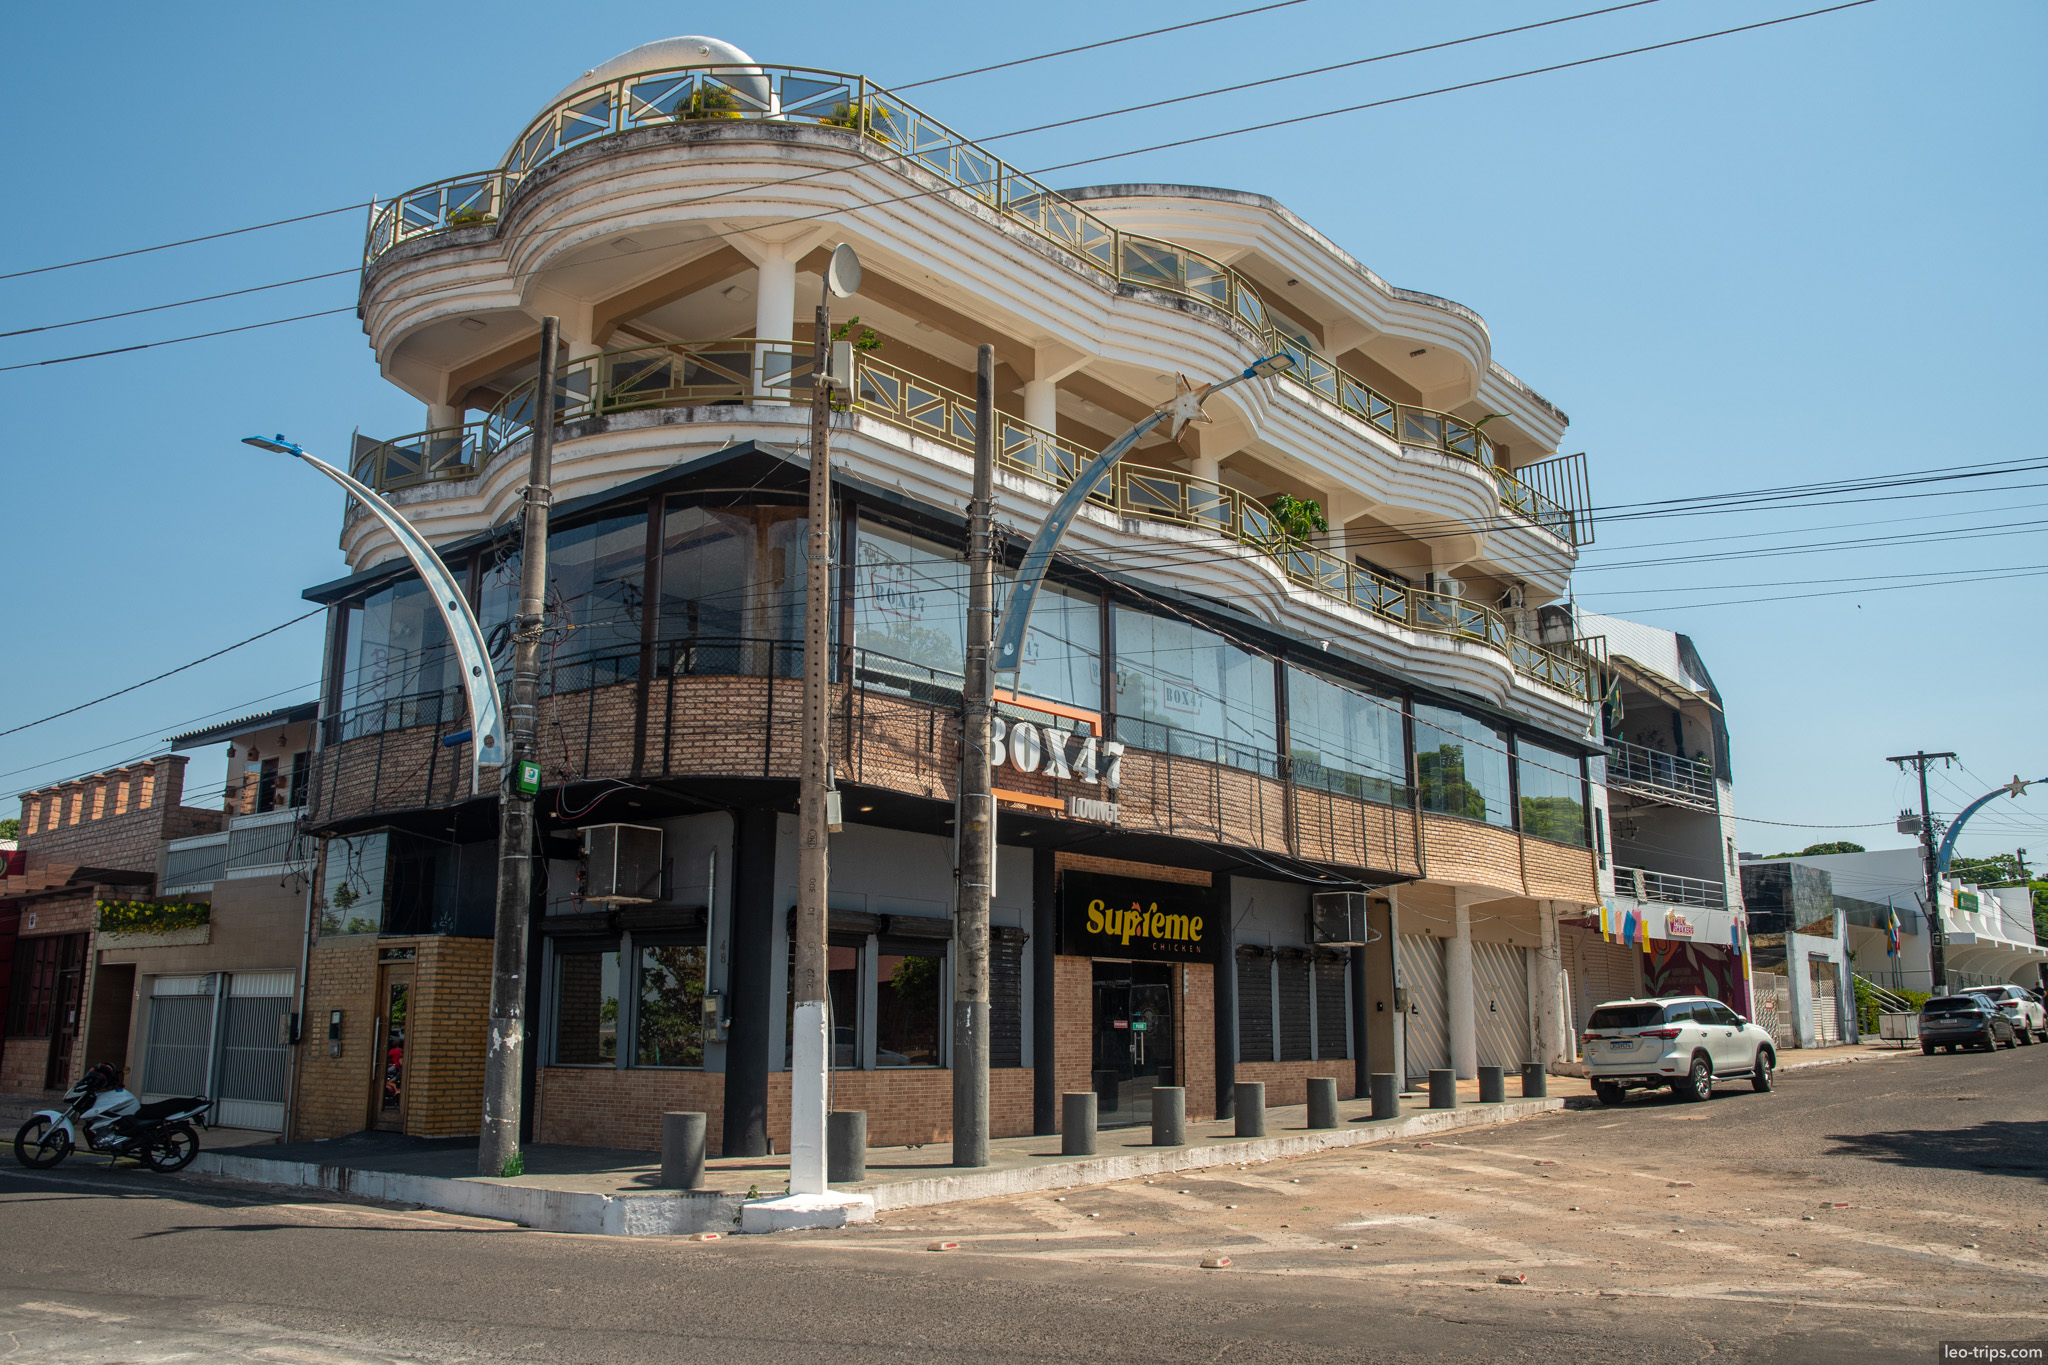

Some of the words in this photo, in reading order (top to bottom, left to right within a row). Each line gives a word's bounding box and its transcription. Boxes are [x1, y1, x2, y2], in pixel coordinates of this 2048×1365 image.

[1166, 687, 1203, 709] BOX47
[991, 716, 1125, 789] BOX47
[1069, 796, 1122, 824] LOUNGE
[808, 877, 817, 894] 300
[1086, 899, 1204, 946] Supreme
[1674, 918, 1686, 926] MILK
[1152, 942, 1201, 953] CHICKEN
